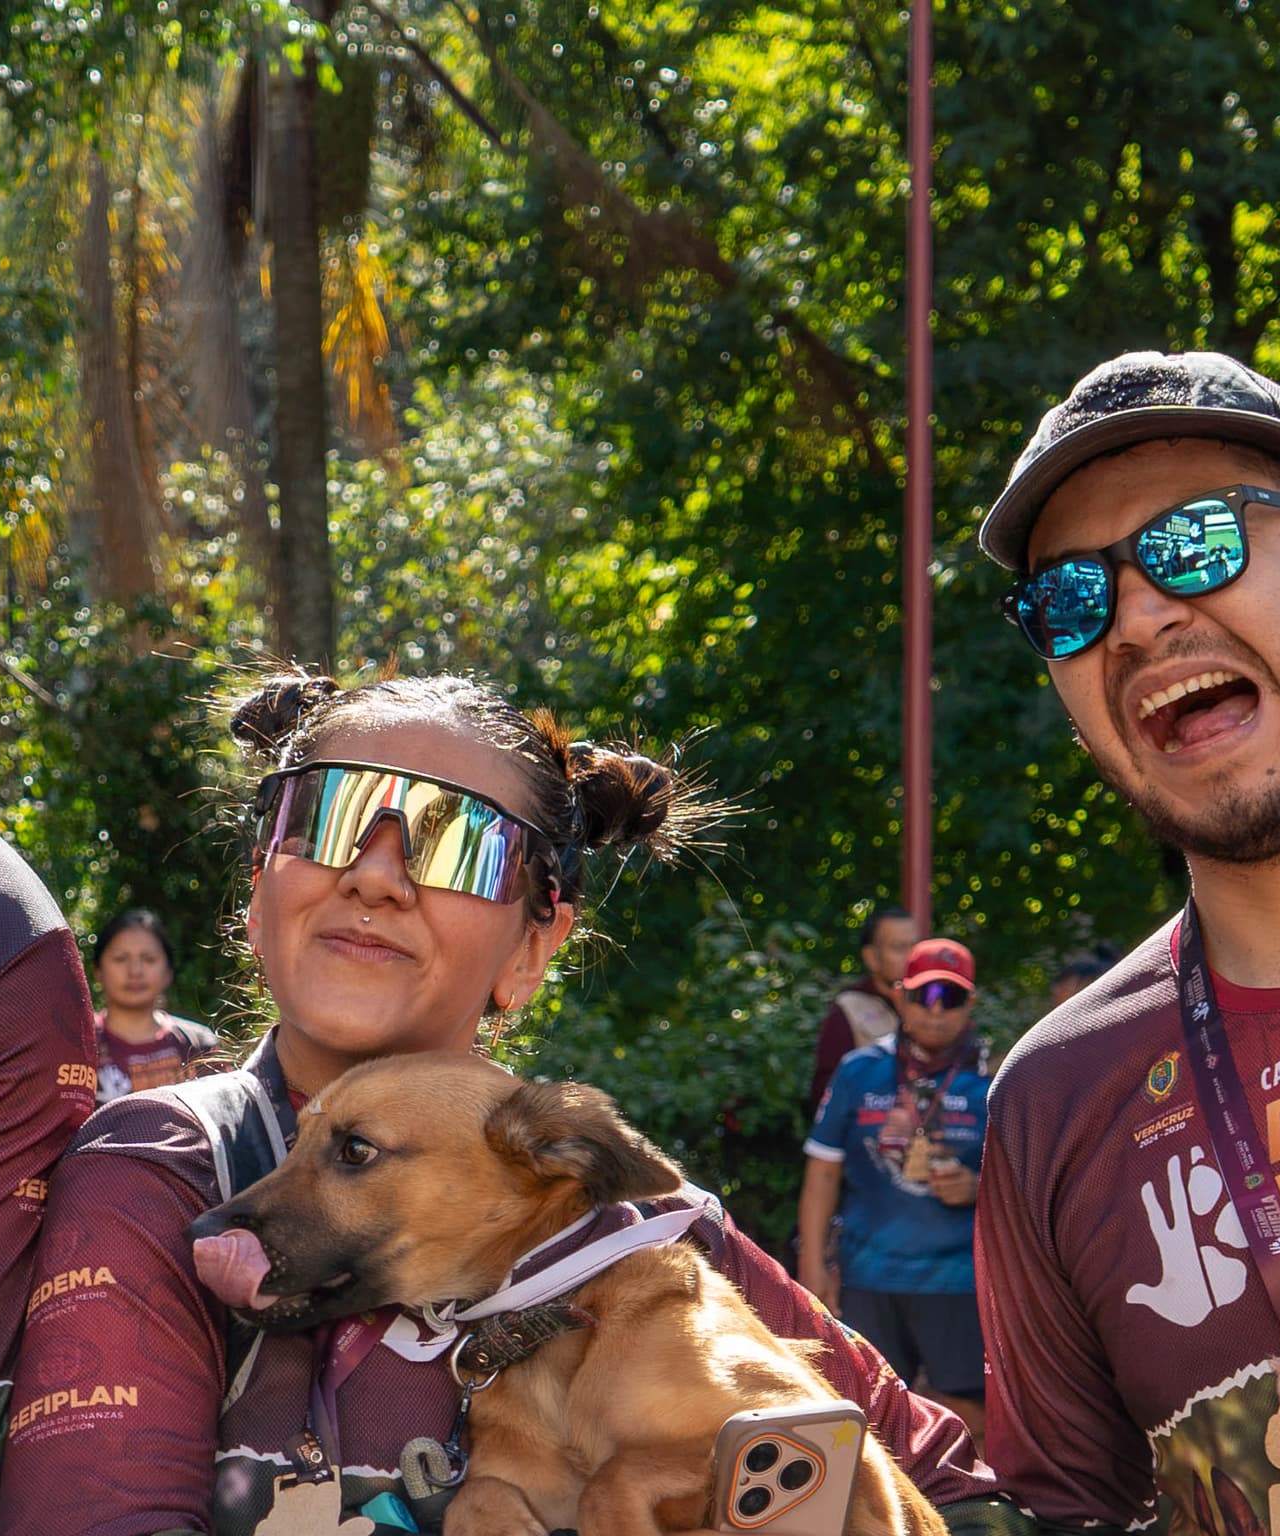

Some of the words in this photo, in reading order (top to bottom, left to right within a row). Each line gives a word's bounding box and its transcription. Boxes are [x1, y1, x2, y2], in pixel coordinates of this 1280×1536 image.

[1133, 1106, 1195, 1142] VERACRUZ
[75, 1291, 108, 1301] MEDIO
[9, 1385, 138, 1439] SEFIPLAN
[72, 1411, 124, 1421] FINANZAS
